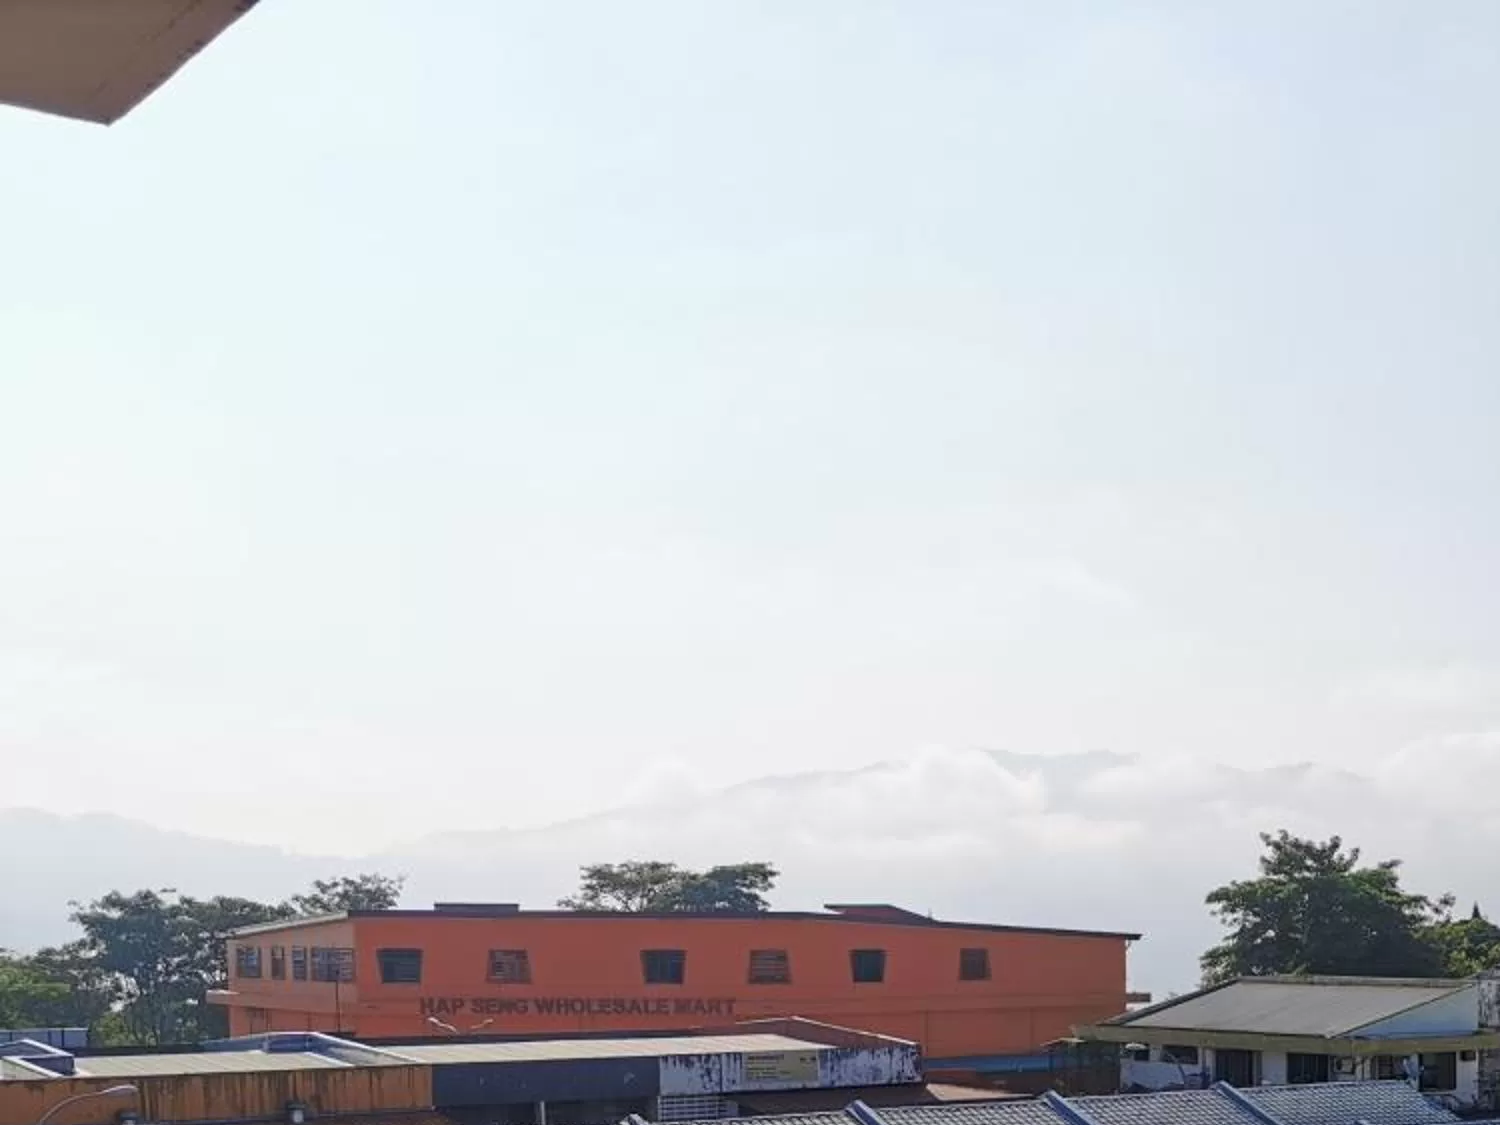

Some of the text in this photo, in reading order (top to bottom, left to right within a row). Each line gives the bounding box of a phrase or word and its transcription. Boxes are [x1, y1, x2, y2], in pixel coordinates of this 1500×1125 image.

[419, 997, 737, 1015] HAP SENG WHOLESALE MART
